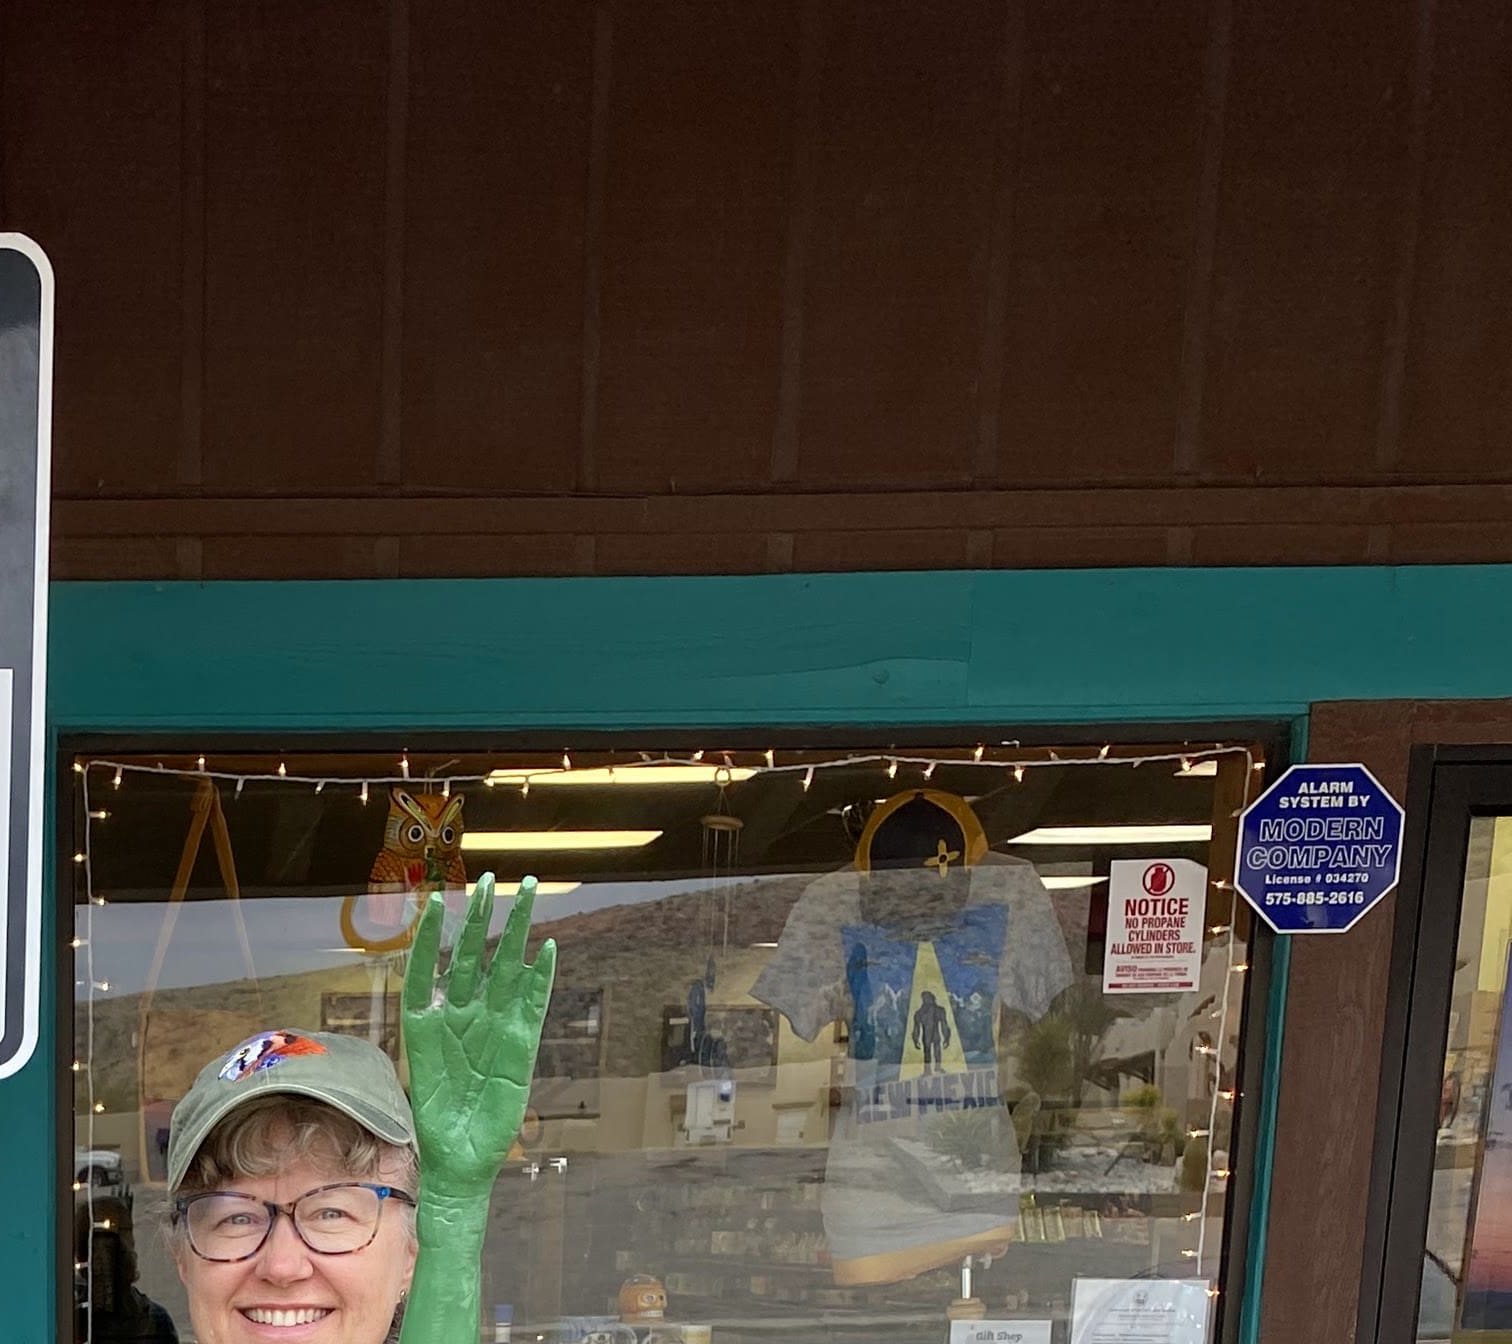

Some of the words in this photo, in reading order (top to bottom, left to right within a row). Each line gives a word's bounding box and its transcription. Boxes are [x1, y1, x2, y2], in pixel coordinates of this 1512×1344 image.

[1298, 782, 1353, 794] ALARM
[1279, 797, 1343, 808] SYSTEM
[1348, 795, 1370, 807] BY
[1259, 817, 1384, 841] MODERN
[1247, 845, 1392, 870] COMPANY
[1265, 874, 1311, 884] License
[1125, 898, 1189, 916] NOTICE
[1125, 918, 1139, 929] NO
[1142, 916, 1186, 928] PROPANE
[1128, 930, 1181, 942] CYLINDERS
[1111, 943, 1152, 955] ALLOWED
[1155, 942, 1163, 954] IN
